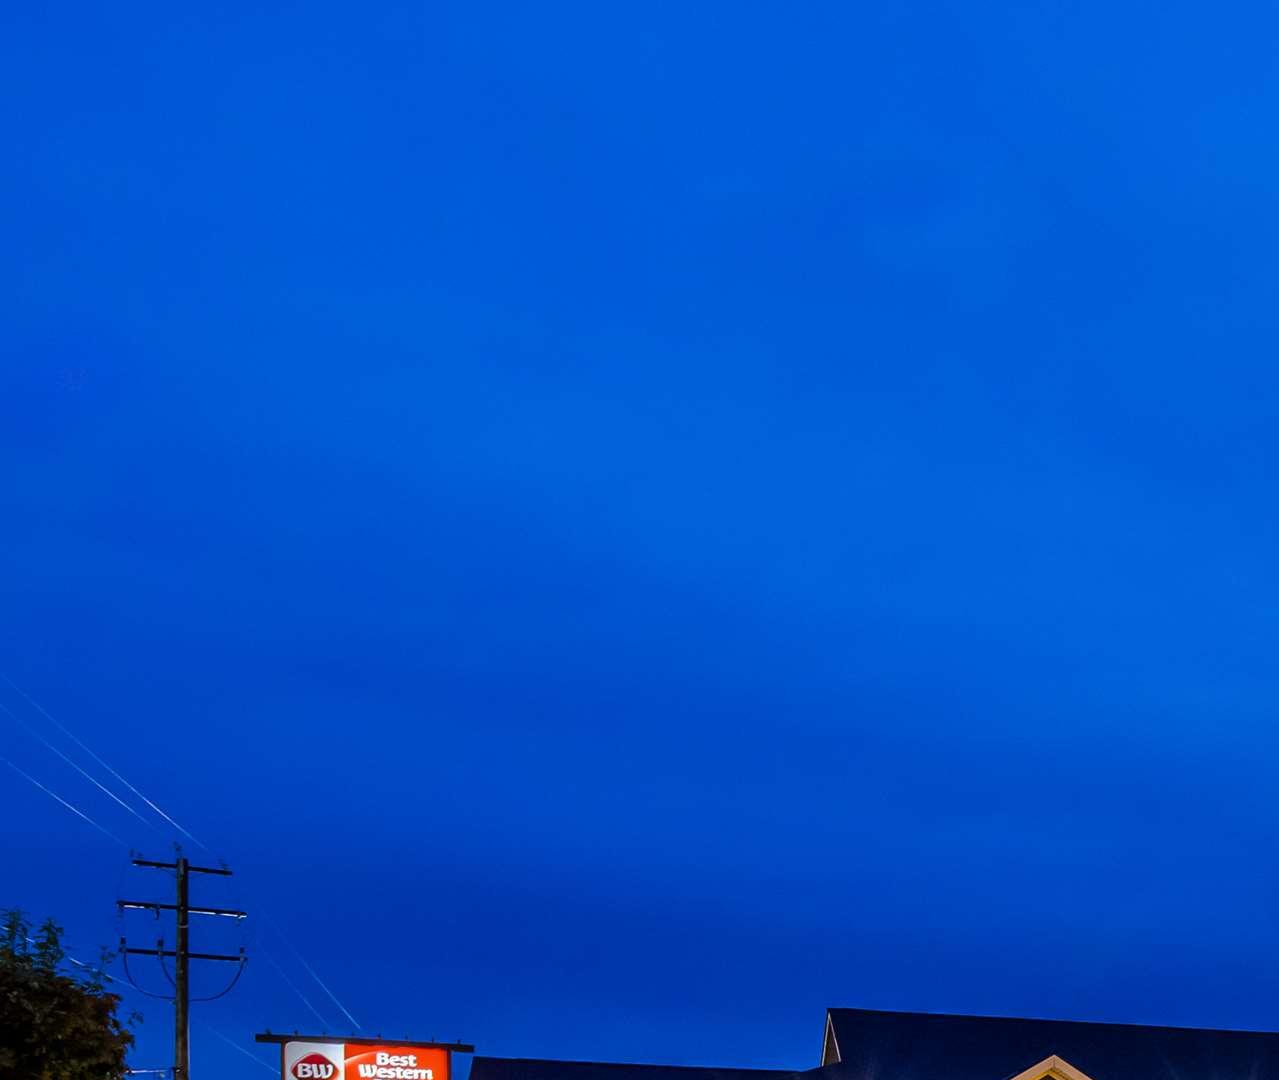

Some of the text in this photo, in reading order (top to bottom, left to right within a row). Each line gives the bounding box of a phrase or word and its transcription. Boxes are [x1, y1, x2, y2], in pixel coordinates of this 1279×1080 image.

[376, 1052, 417, 1067] Best
[297, 1063, 334, 1078] BW
[358, 1064, 434, 1080] Western
